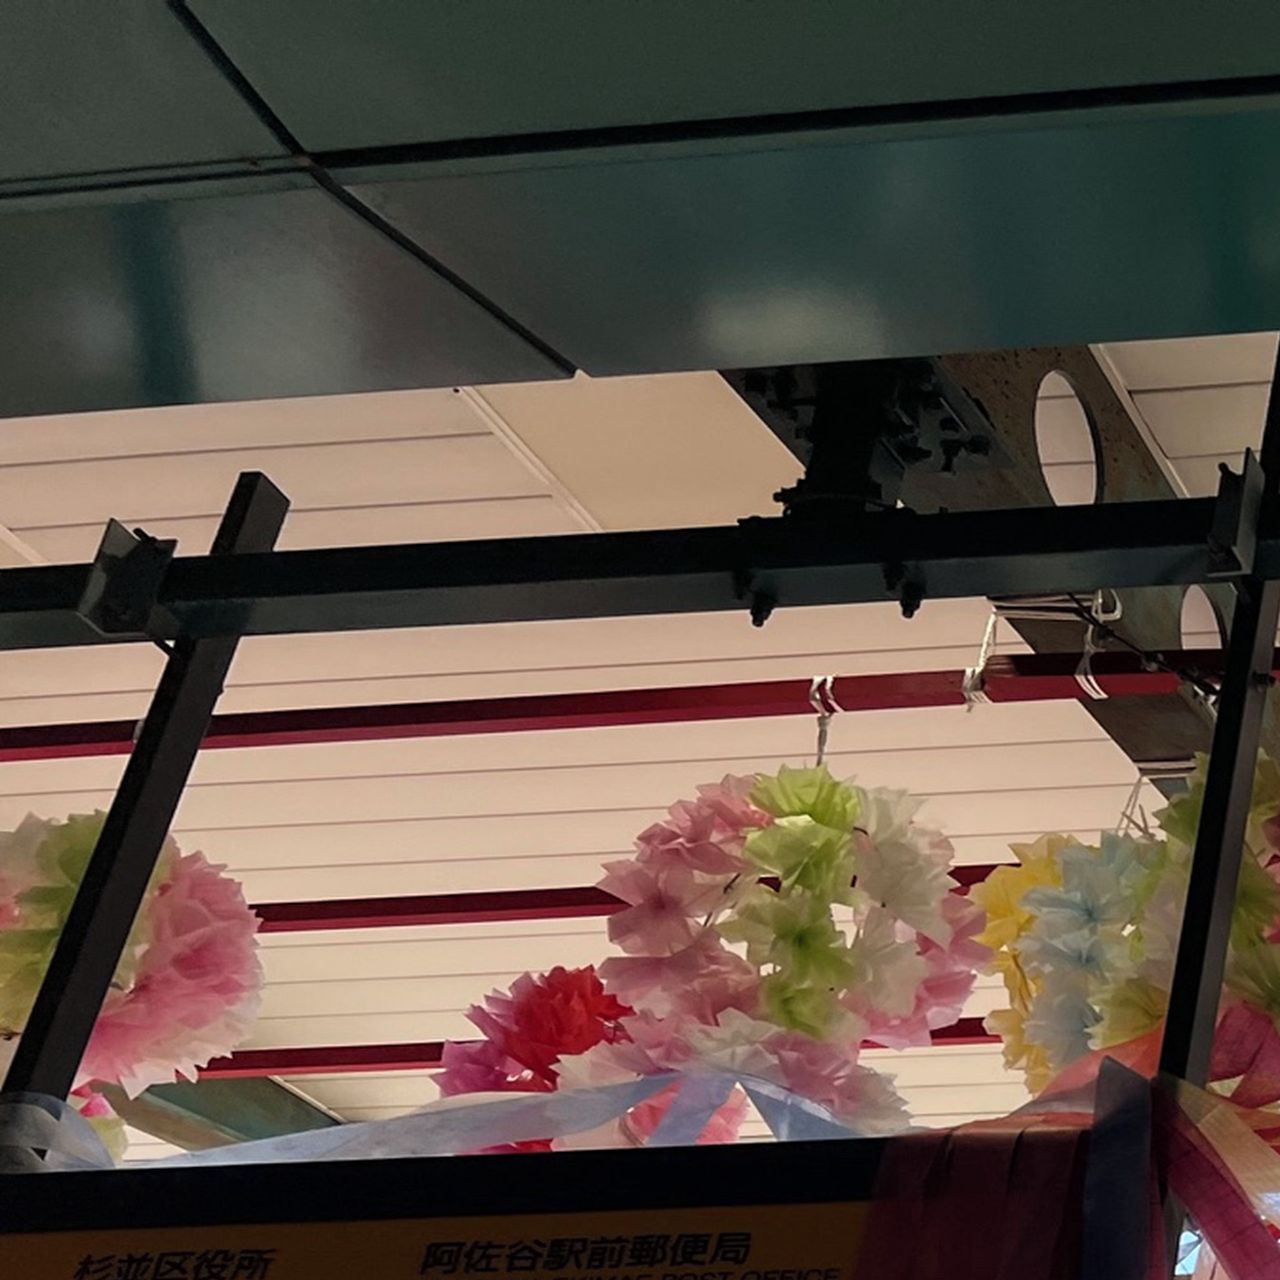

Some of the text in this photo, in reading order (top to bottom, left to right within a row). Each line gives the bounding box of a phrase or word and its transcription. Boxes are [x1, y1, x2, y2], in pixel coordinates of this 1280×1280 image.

[420, 1233, 752, 1275] 阿佐谷駅前郵便局
